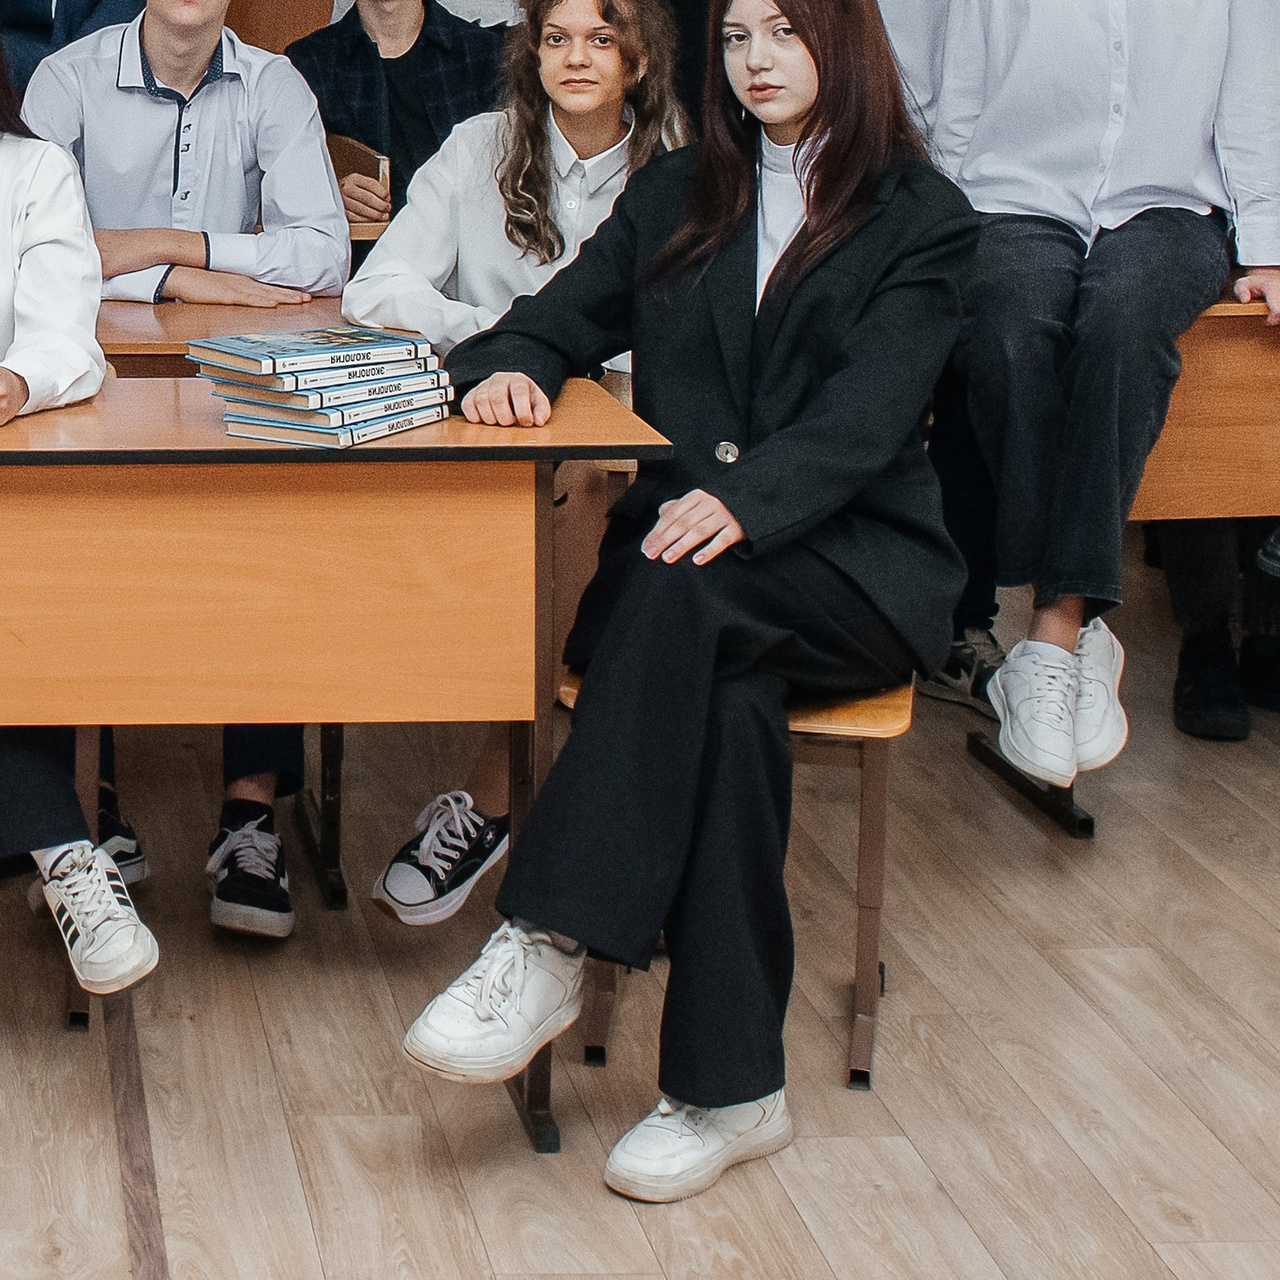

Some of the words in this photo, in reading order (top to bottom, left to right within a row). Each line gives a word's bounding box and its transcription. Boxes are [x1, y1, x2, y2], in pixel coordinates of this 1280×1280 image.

[330, 351, 372, 365] ЭКОЛОГИЯ
[347, 366, 386, 380] ЭКОЛОГИЯ
[367, 382, 402, 397] ЭКОЛОГИЯ
[383, 397, 414, 413] ЭКОЛОГИЯ
[387, 416, 415, 432] ЭКОЛОГИЯ
